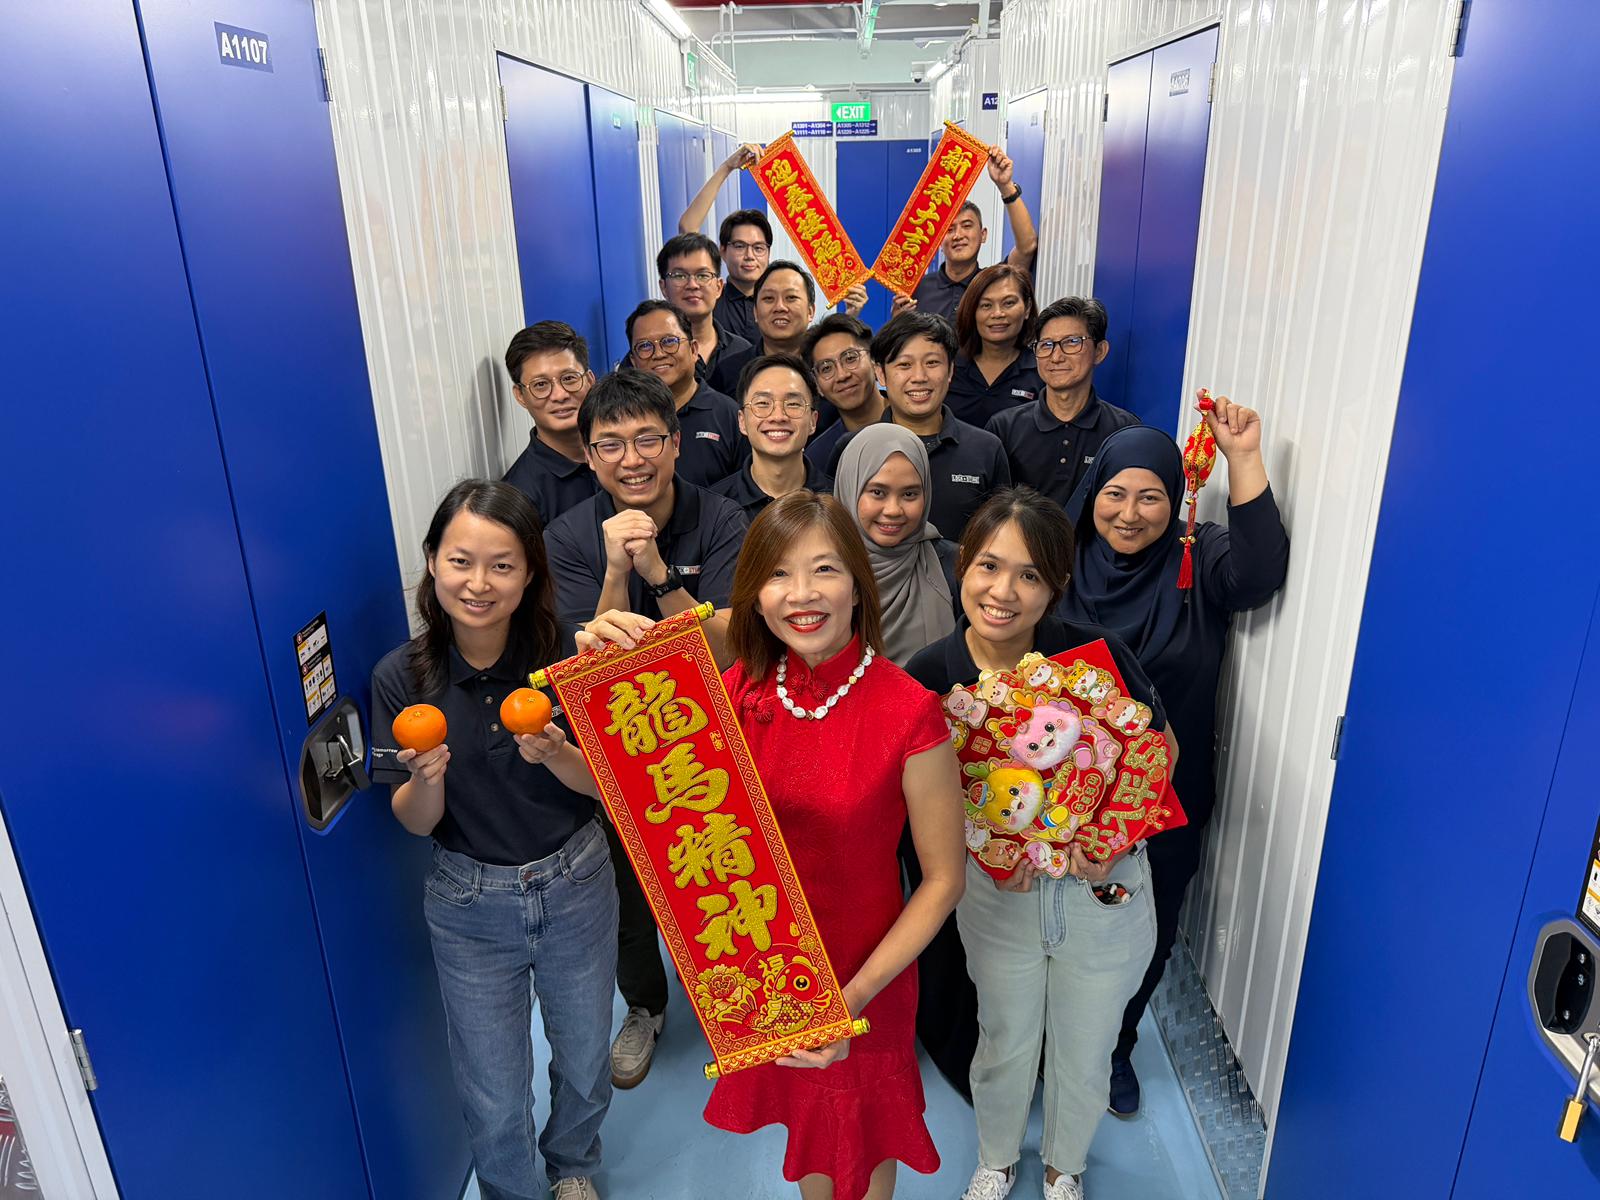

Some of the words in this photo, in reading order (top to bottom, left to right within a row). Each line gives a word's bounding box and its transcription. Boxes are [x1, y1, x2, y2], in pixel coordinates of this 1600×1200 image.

[222, 31, 268, 65] A1107
[841, 105, 865, 119] EXIT
[765, 158, 842, 265] 迎春接福
[901, 145, 973, 256] 新春大吉
[604, 670, 778, 961] 龍馬精神
[1074, 731, 1169, 861] 出入平安
